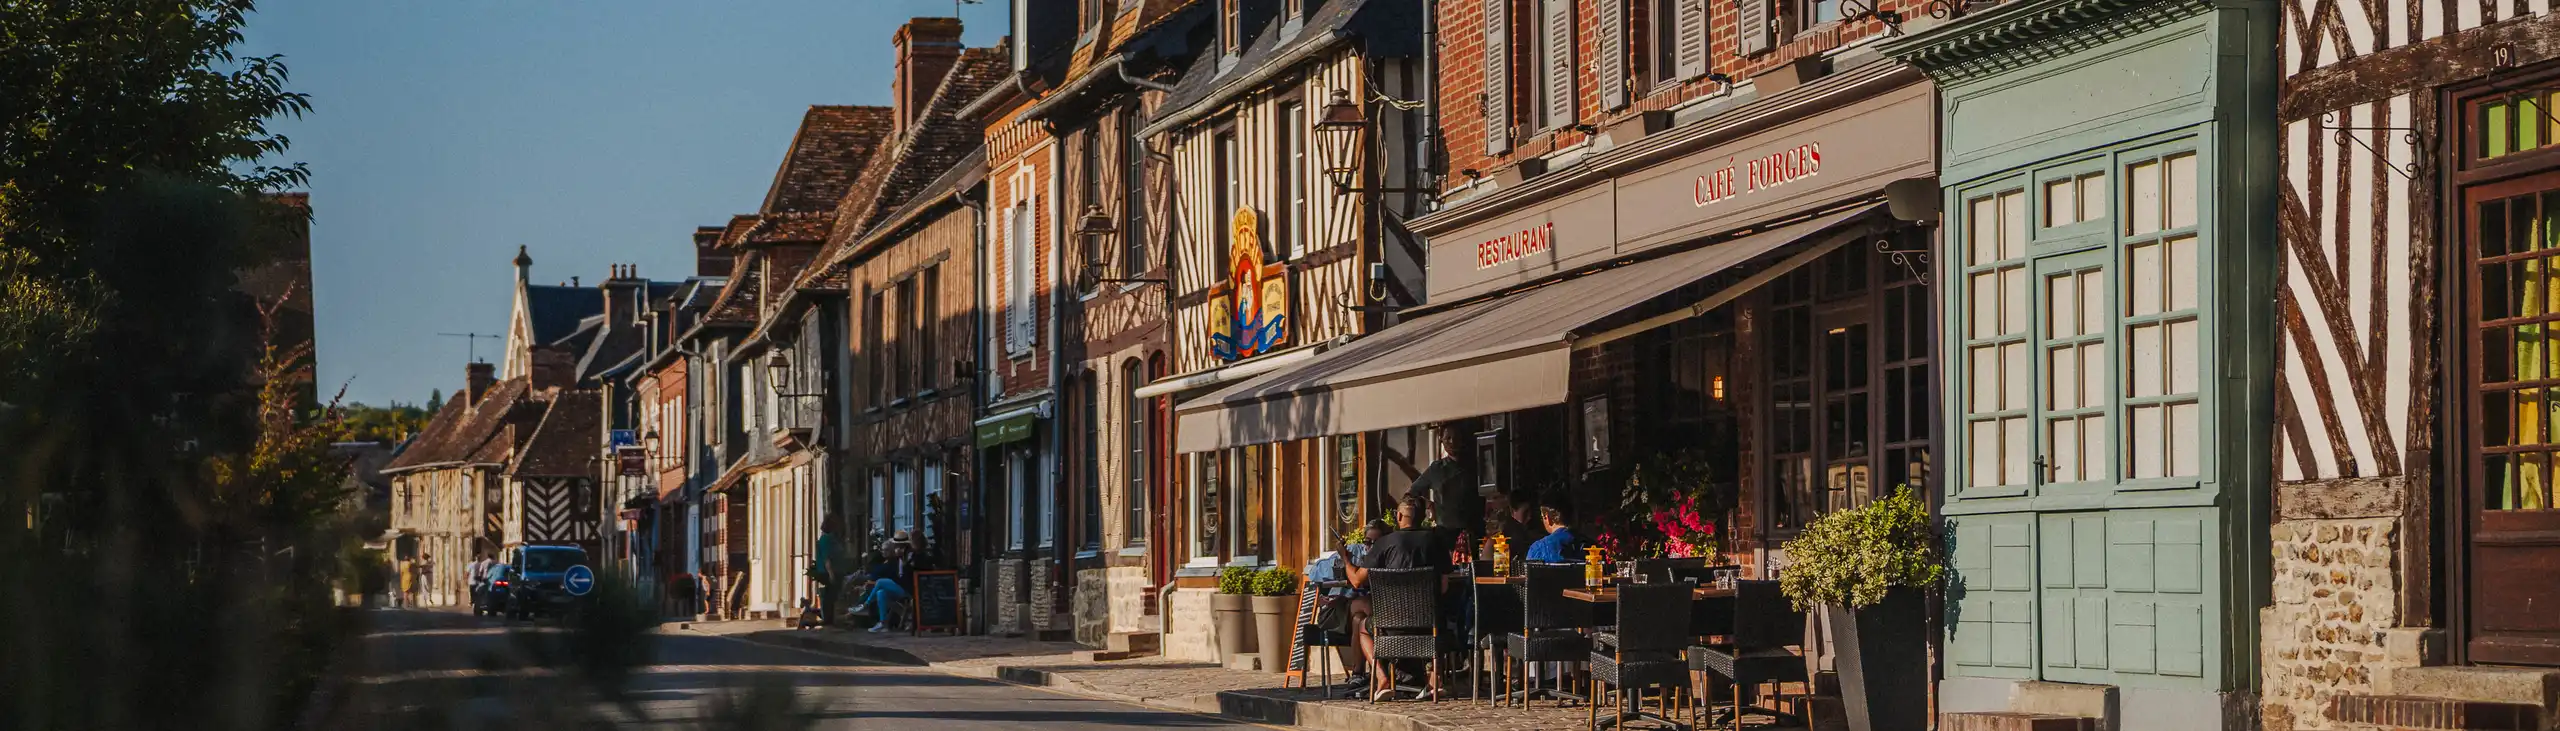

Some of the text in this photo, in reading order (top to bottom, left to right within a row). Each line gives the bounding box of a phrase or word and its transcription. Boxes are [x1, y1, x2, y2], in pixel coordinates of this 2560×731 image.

[2494, 47, 2508, 67] 19
[1694, 142, 1821, 208] CAFÉ FORGES
[1477, 223, 1554, 270] RESTAURANT
